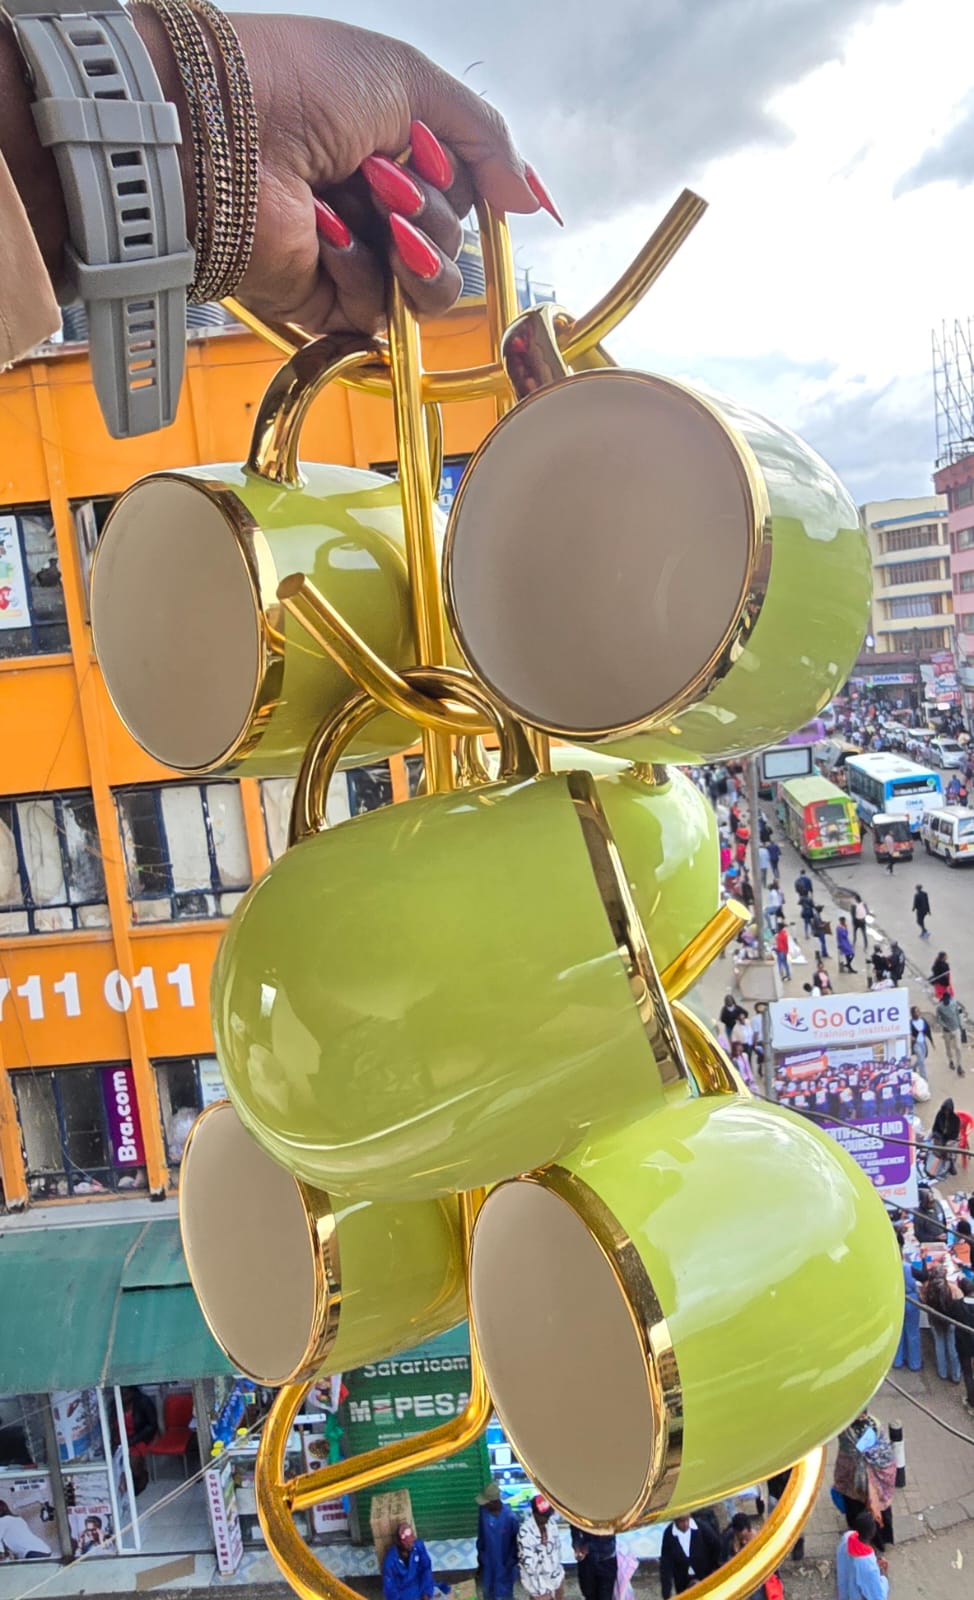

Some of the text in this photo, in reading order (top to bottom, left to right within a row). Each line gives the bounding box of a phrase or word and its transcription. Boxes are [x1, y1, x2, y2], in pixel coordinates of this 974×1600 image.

[104, 963, 195, 1012] 011
[812, 1005, 900, 1029] GoCare
[813, 1029, 855, 1039] Training
[111, 1070, 138, 1162] Bra.com
[881, 1120, 904, 1136] AND
[208, 1473, 229, 1566] CHURCH ITEMS
